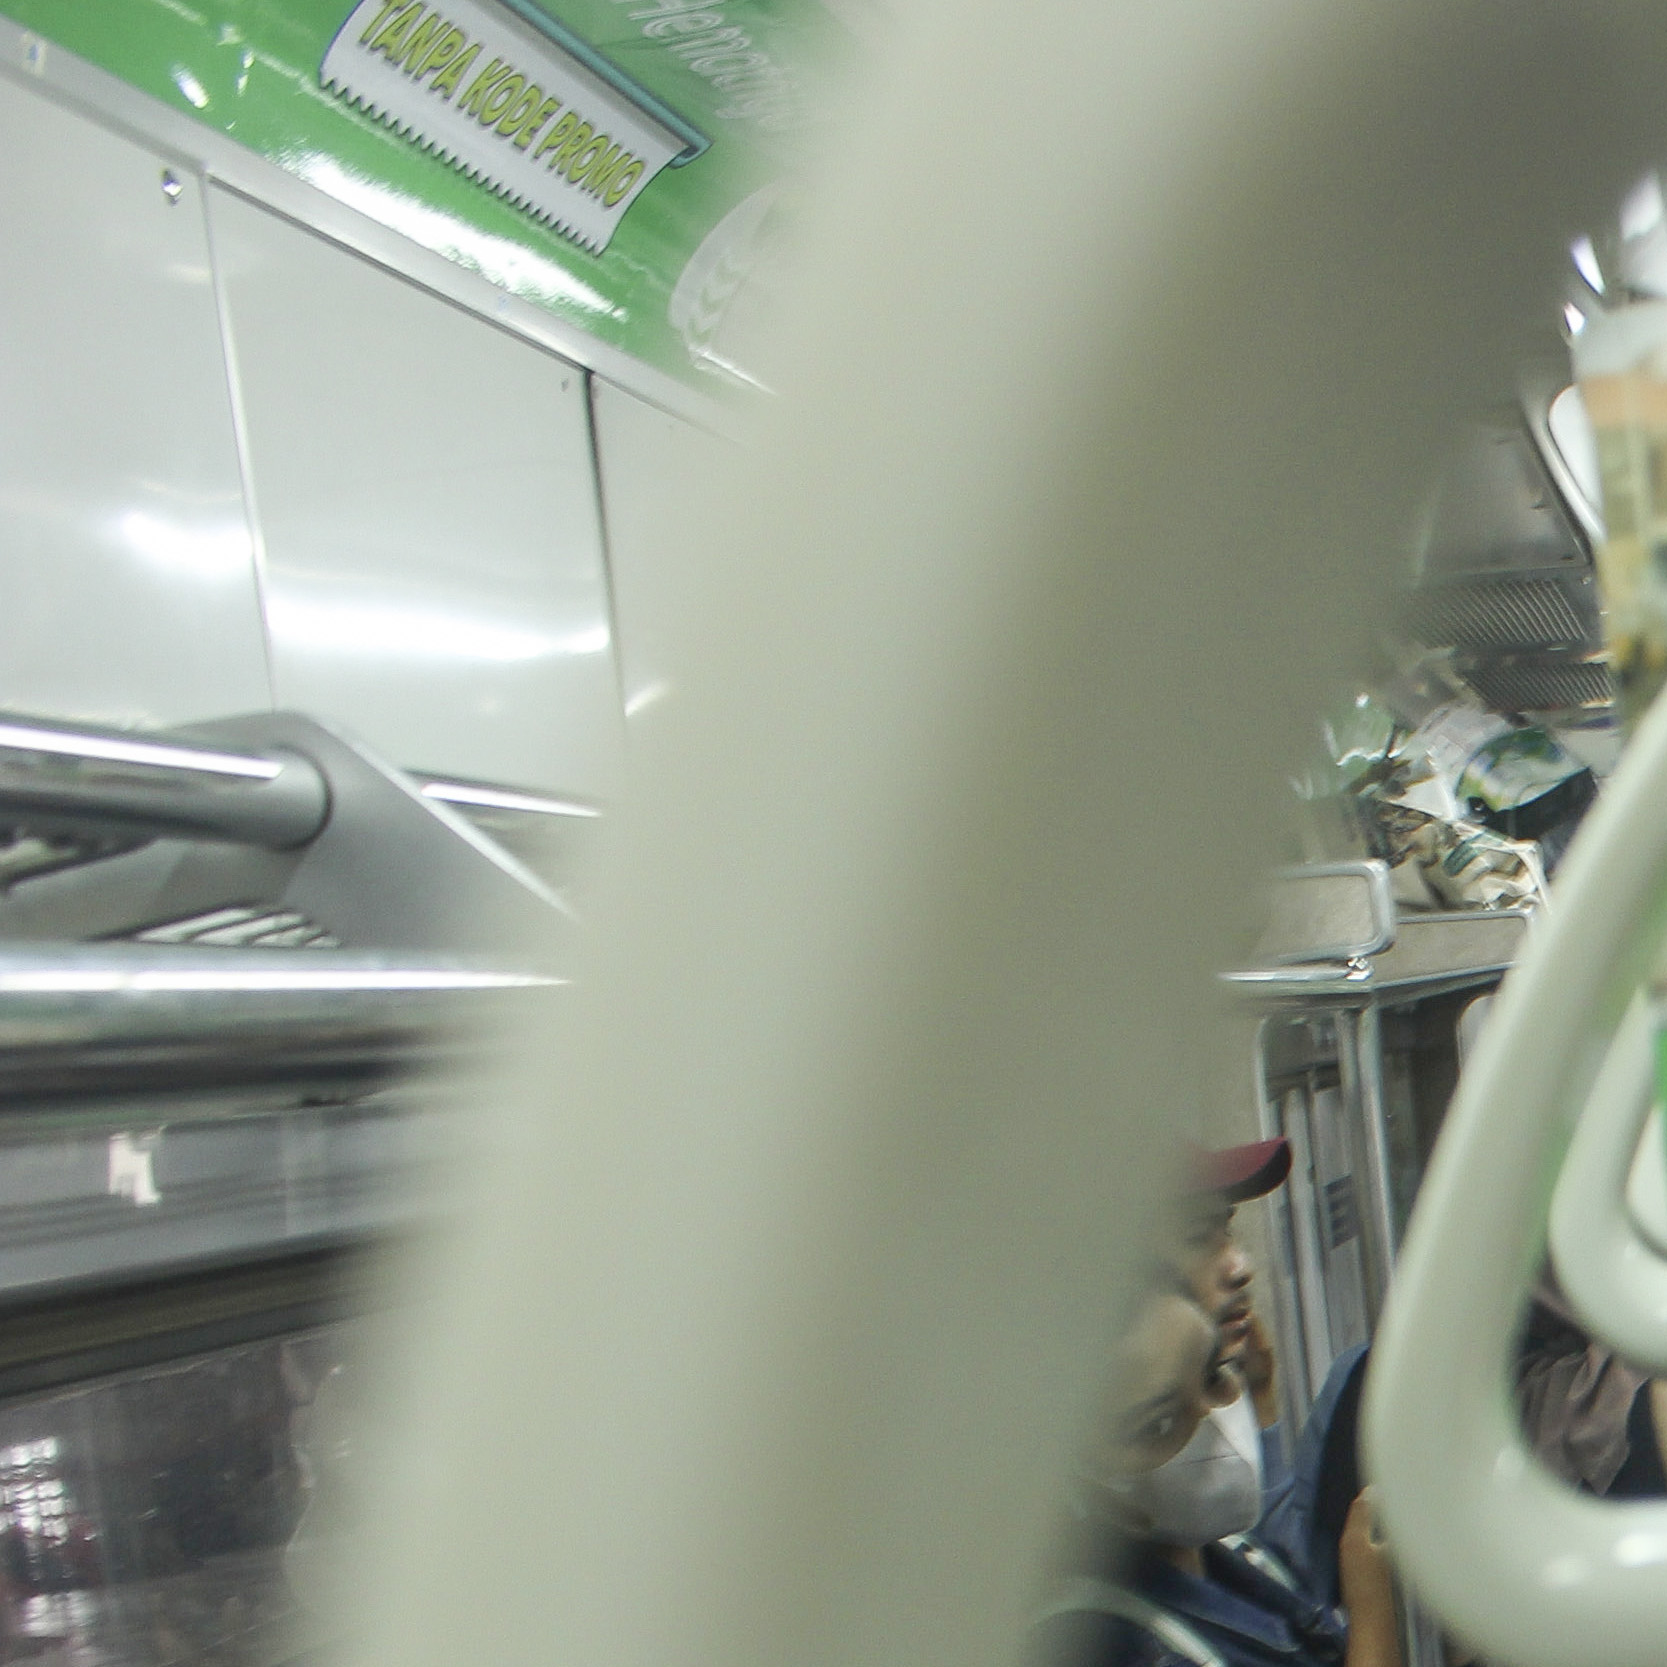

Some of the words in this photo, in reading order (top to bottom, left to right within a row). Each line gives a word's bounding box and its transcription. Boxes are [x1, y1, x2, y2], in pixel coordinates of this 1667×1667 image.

[358, 0, 482, 101] TANPA
[457, 57, 561, 151] KODE
[533, 110, 647, 208] PROMO
